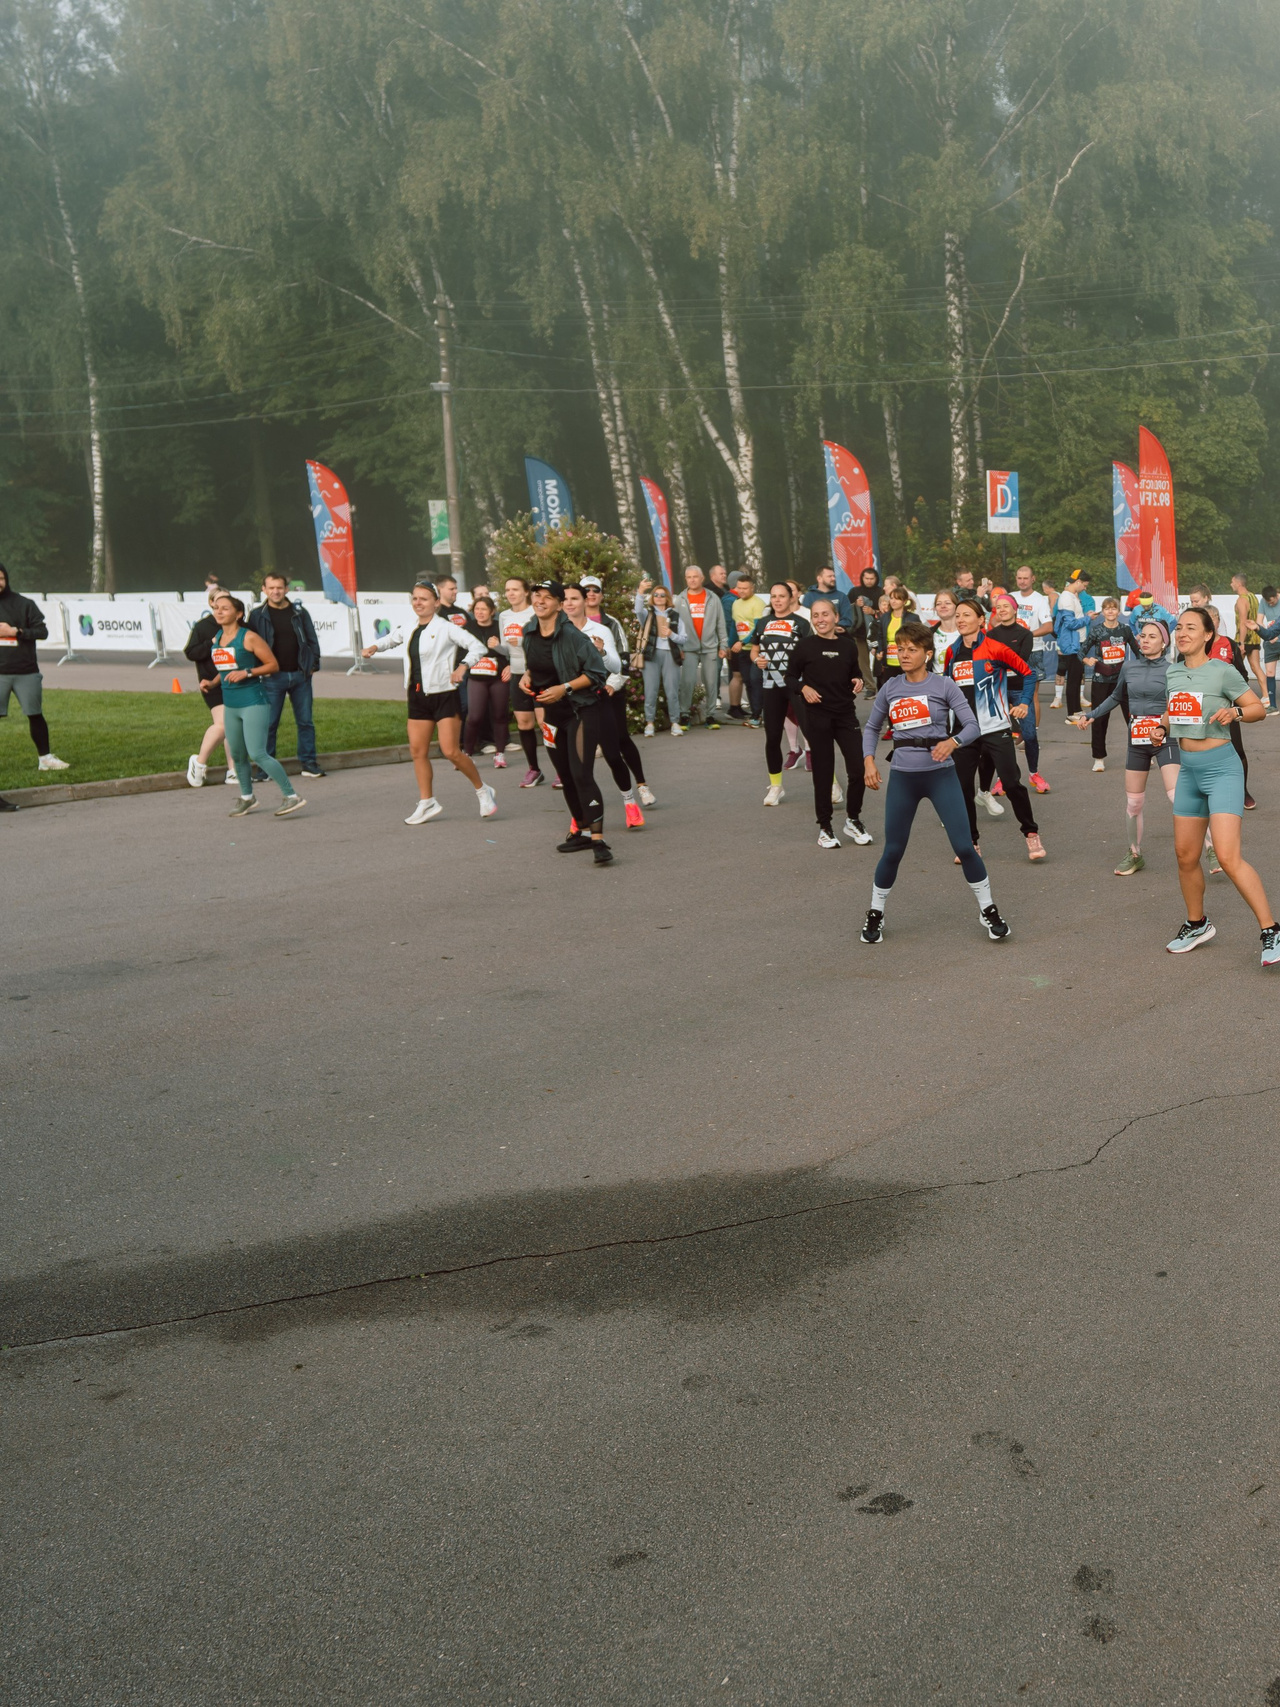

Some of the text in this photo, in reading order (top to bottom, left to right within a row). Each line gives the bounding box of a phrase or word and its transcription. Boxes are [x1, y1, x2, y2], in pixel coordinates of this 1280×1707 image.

[997, 484, 1012, 513] D
[97, 620, 142, 631] ЭВОКОМ
[897, 705, 919, 718] 2015
[1174, 702, 1193, 712] 2105
